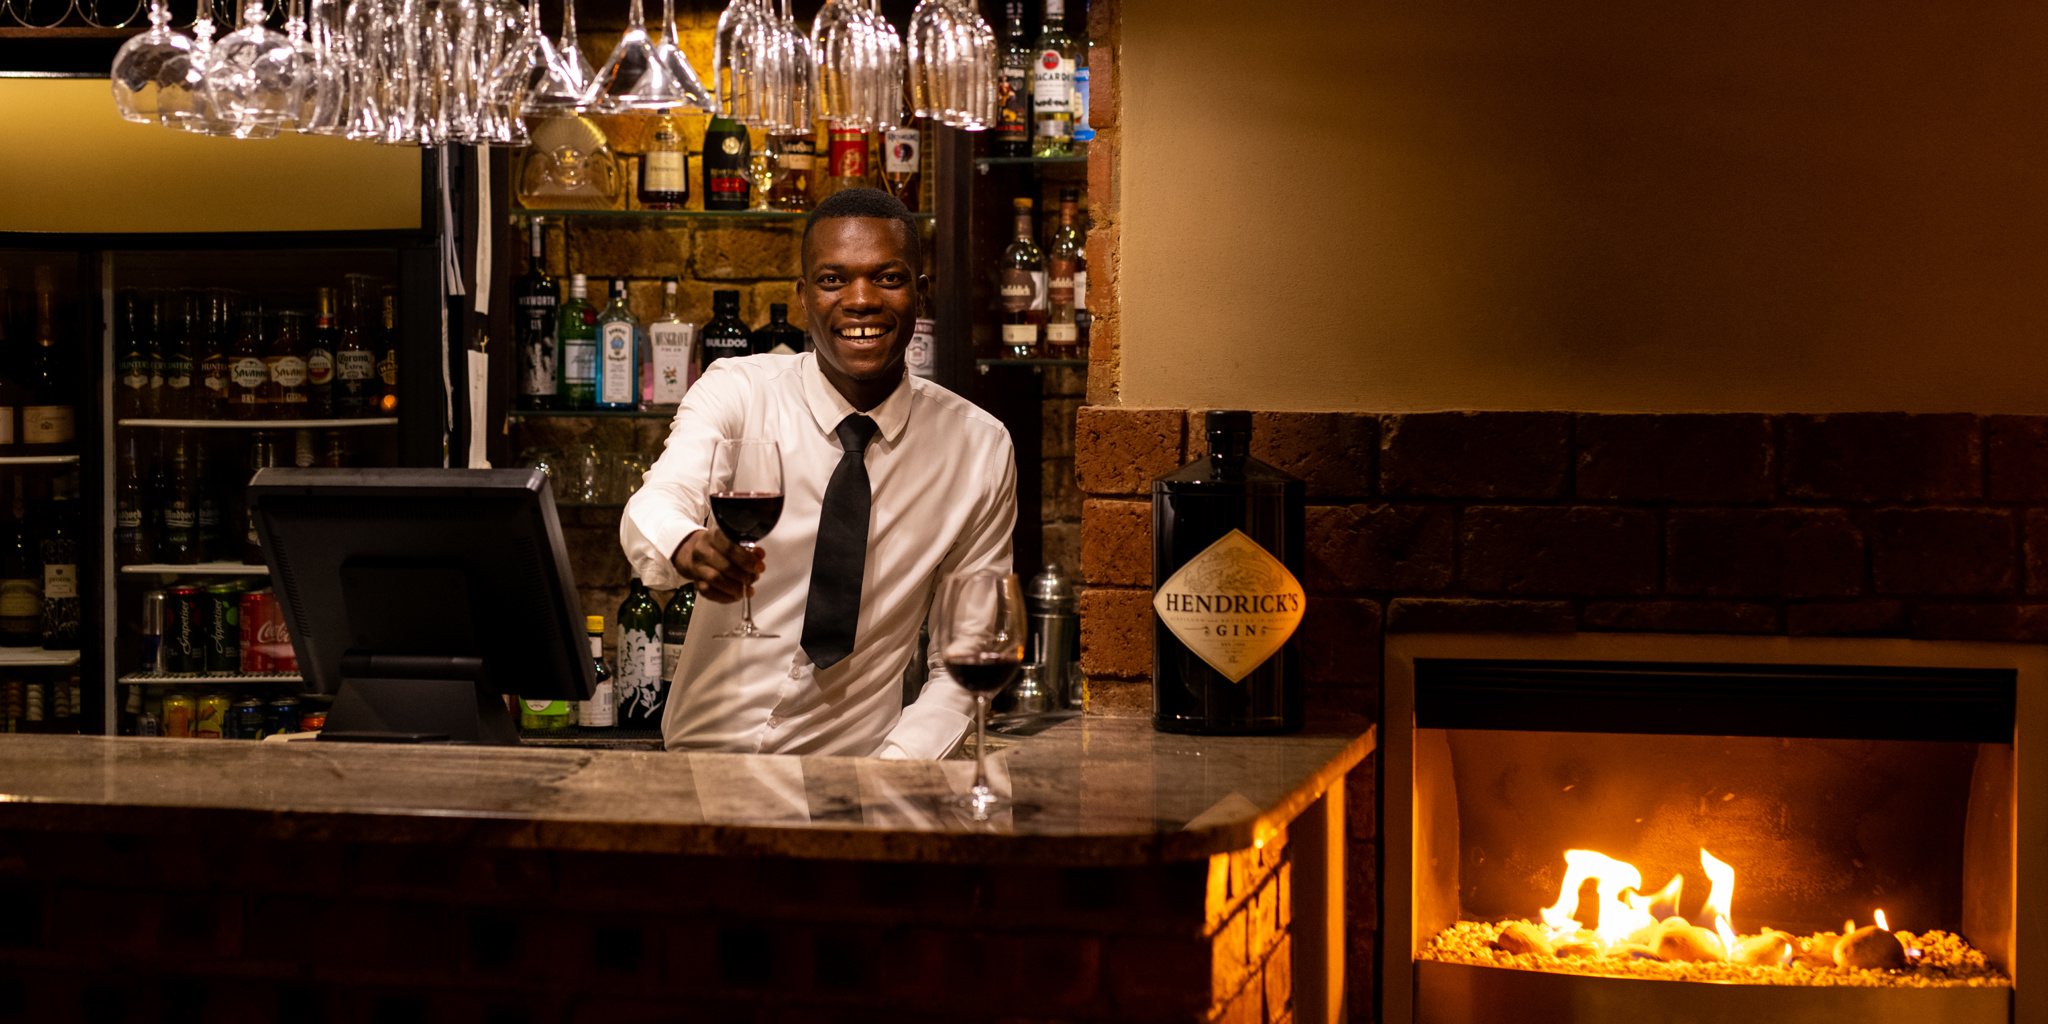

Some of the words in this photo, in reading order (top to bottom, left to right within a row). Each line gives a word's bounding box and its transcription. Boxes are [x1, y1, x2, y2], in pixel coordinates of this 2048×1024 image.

[706, 337, 748, 348] BULLDOG
[338, 353, 370, 365] Corona
[1166, 593, 1299, 614] HENDRICK'S
[1216, 624, 1257, 636] GIN
